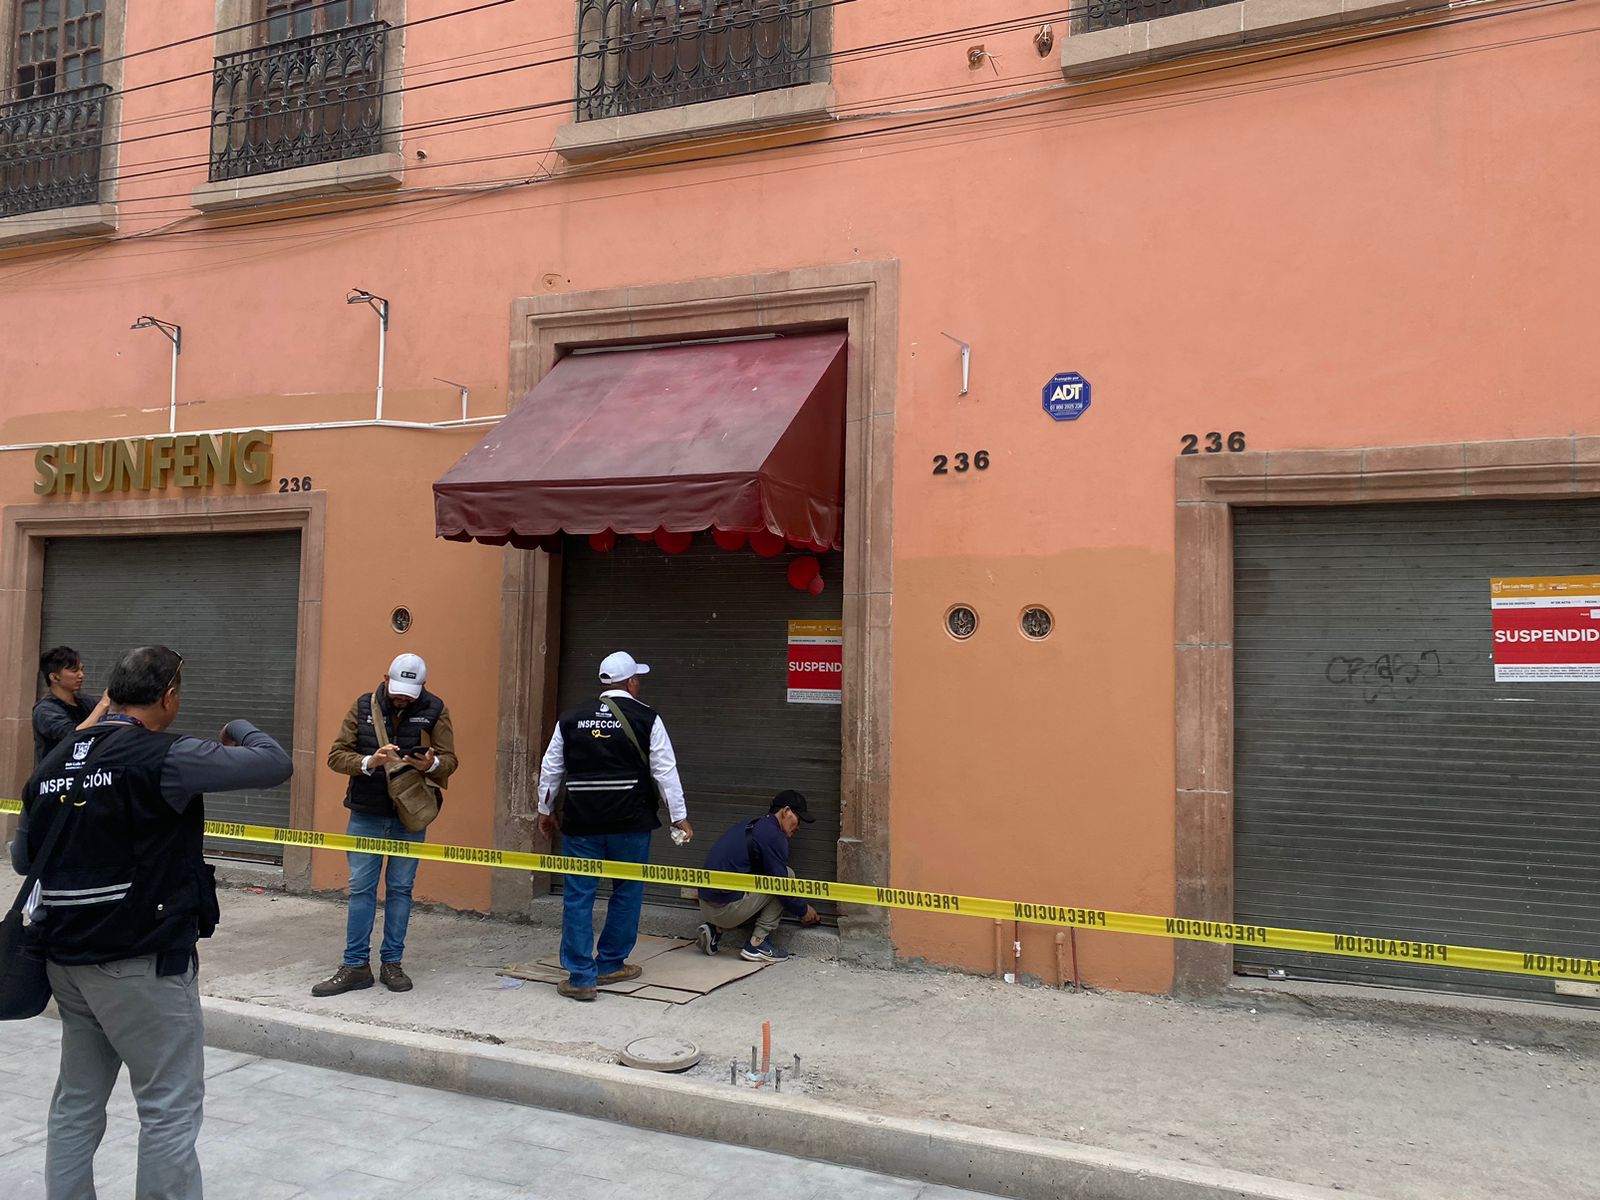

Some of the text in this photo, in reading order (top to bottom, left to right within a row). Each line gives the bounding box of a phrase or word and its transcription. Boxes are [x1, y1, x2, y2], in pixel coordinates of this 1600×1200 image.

[1050, 383, 1083, 402] ADT
[1180, 431, 1246, 454] 236
[34, 429, 273, 496] SHUNFENG
[933, 450, 990, 475] 236
[279, 476, 312, 493] 236
[1494, 629, 1600, 642] SUSPENDID
[788, 661, 842, 672] SUSPEND
[39, 768, 112, 795] INSPECIÓN
